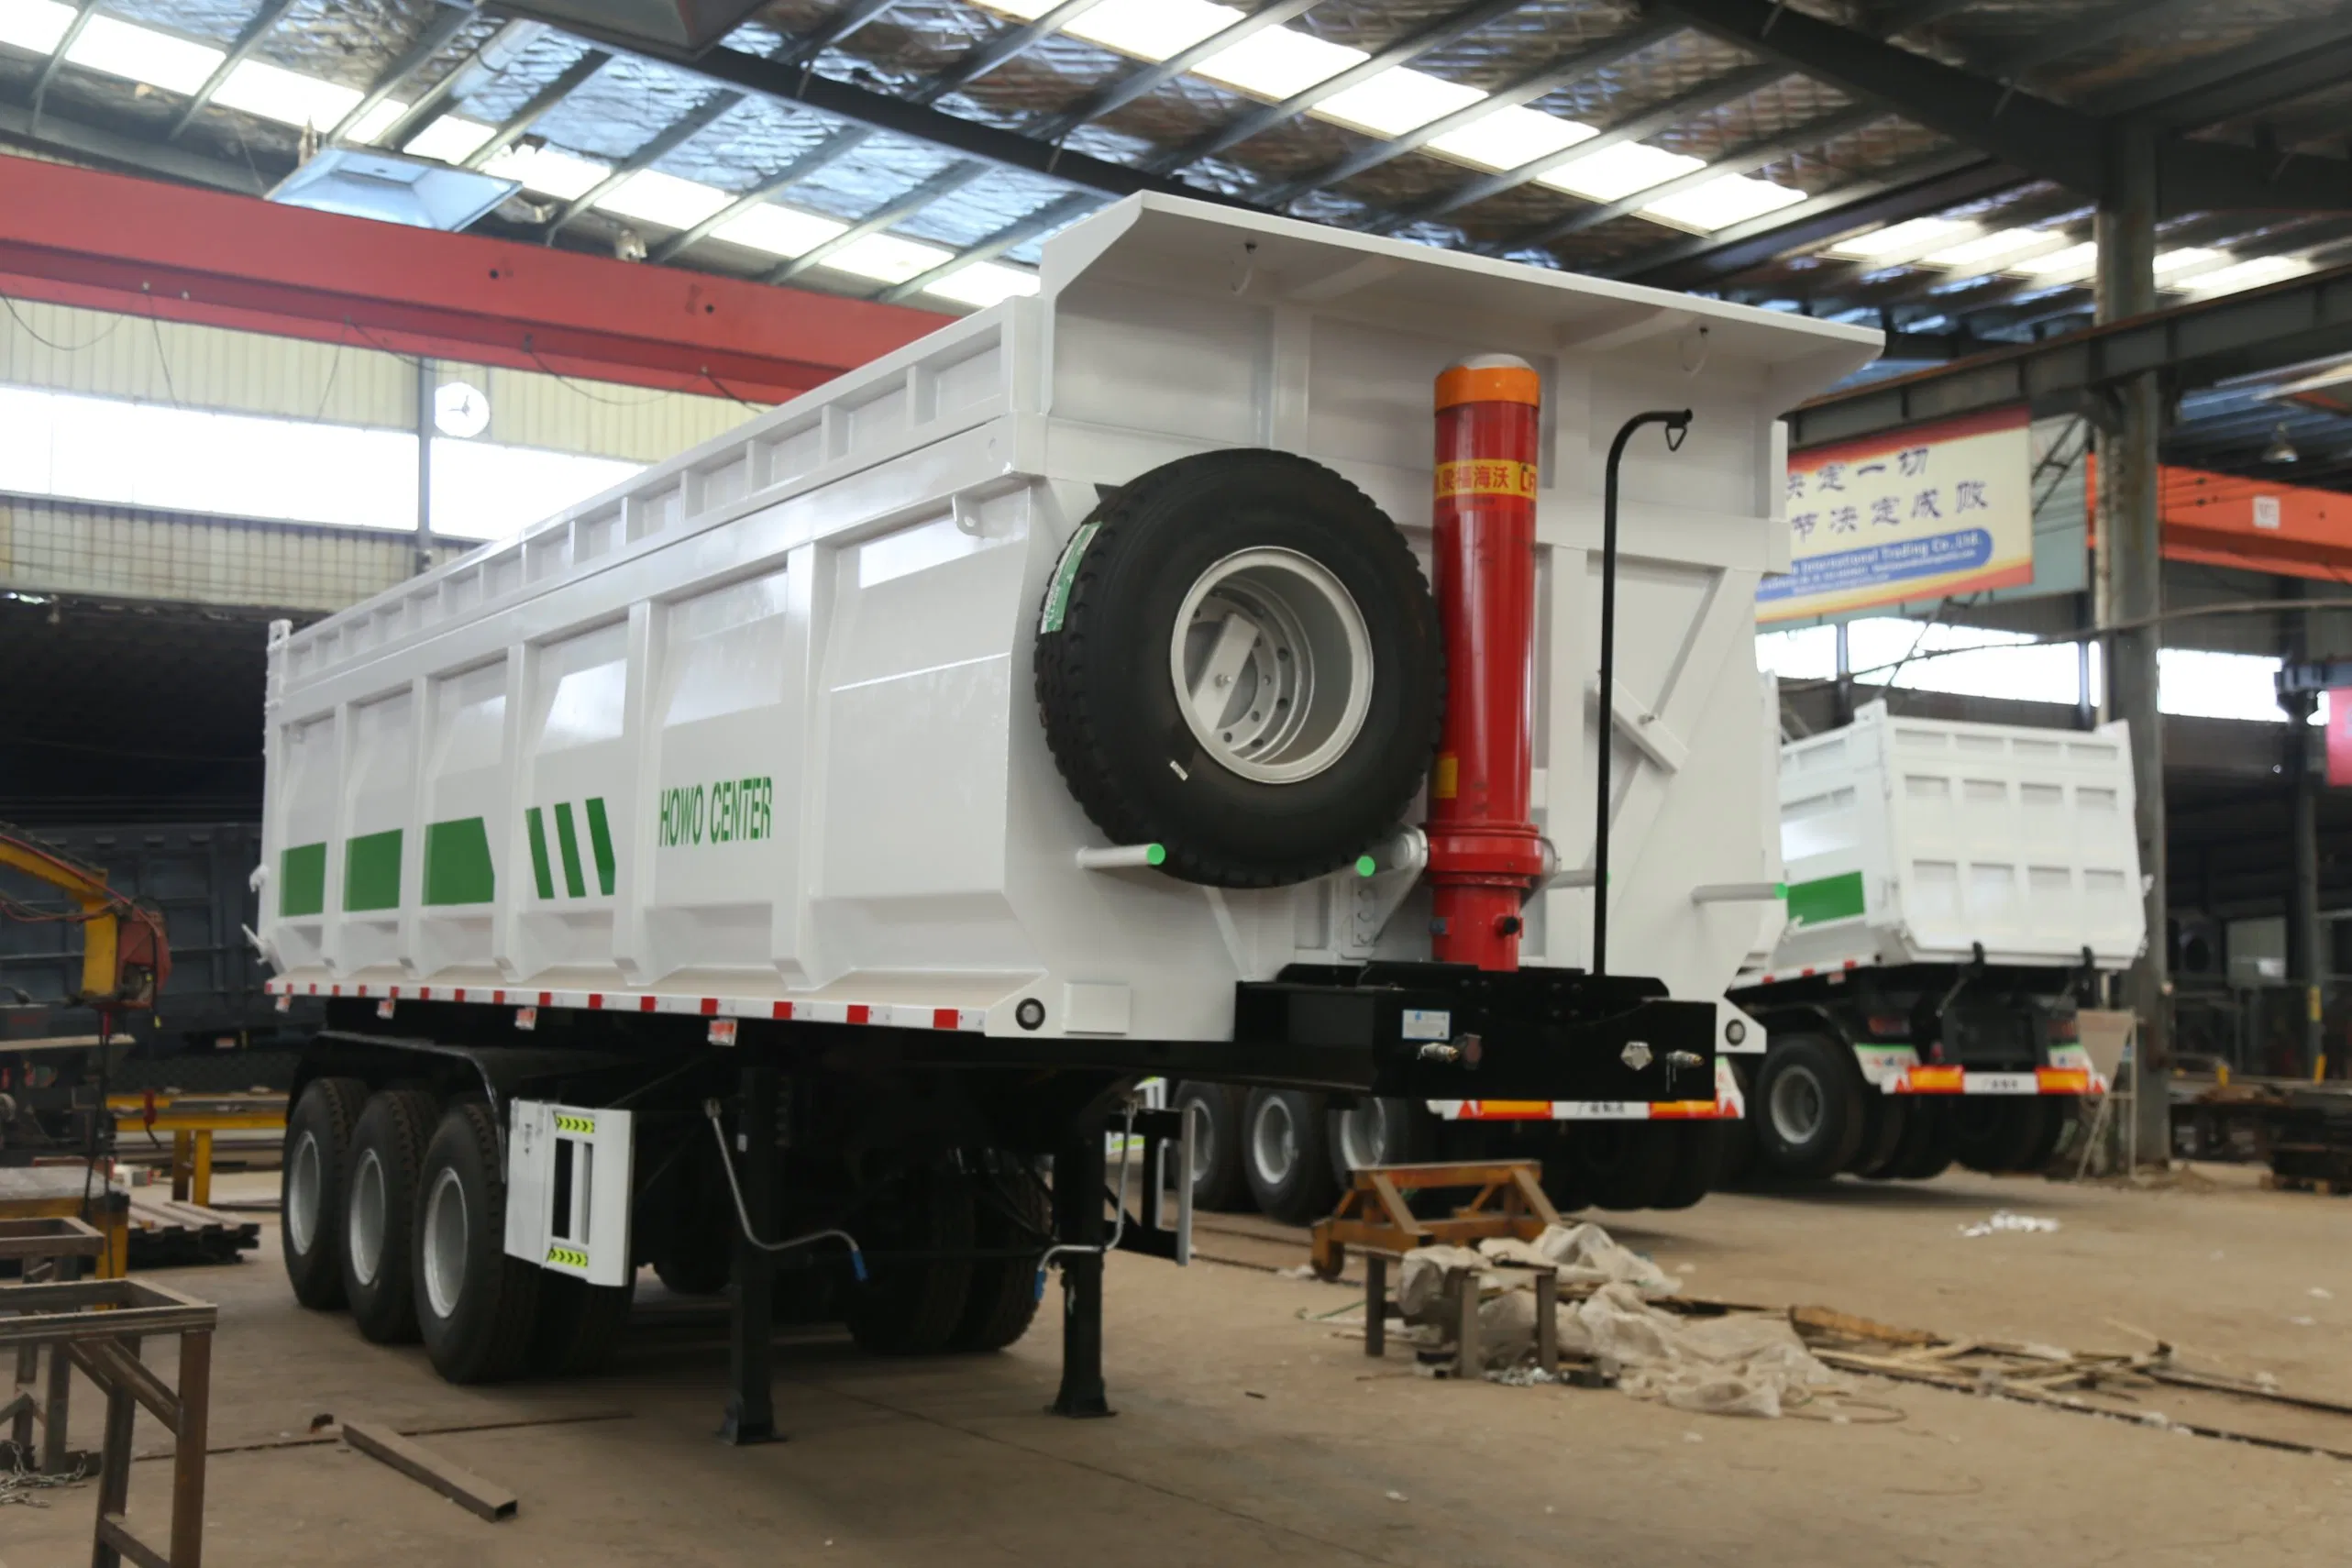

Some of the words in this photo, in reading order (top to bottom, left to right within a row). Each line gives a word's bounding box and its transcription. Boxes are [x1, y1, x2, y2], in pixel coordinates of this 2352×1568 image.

[1882, 542, 1929, 560] Trading
[659, 784, 704, 847] HOWO
[710, 776, 772, 844] CENTER
